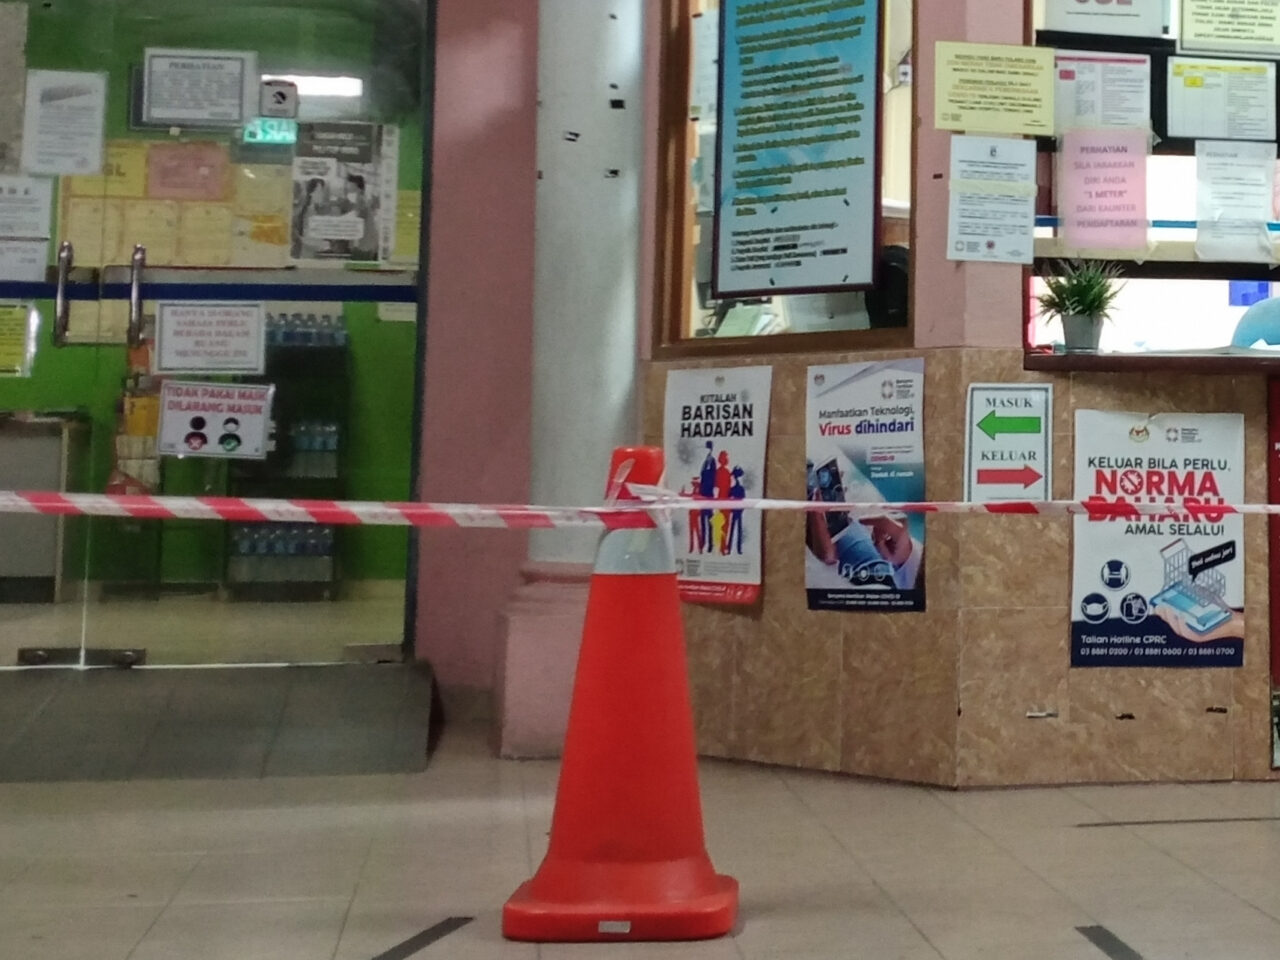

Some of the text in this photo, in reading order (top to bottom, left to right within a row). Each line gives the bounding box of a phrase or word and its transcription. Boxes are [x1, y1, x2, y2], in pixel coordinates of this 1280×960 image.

[167, 400, 223, 413] DILARANG
[985, 396, 1034, 409] MASUK
[681, 404, 753, 421] BARISAN
[681, 421, 754, 438] HADAPAN
[819, 417, 915, 436] Virus dihindari
[980, 449, 1038, 463] KELUAR
[1088, 456, 1143, 468] KELUAR
[1148, 457, 1179, 469] BILA
[1095, 469, 1220, 496] NORMA
[1124, 523, 1164, 535] AMAL
